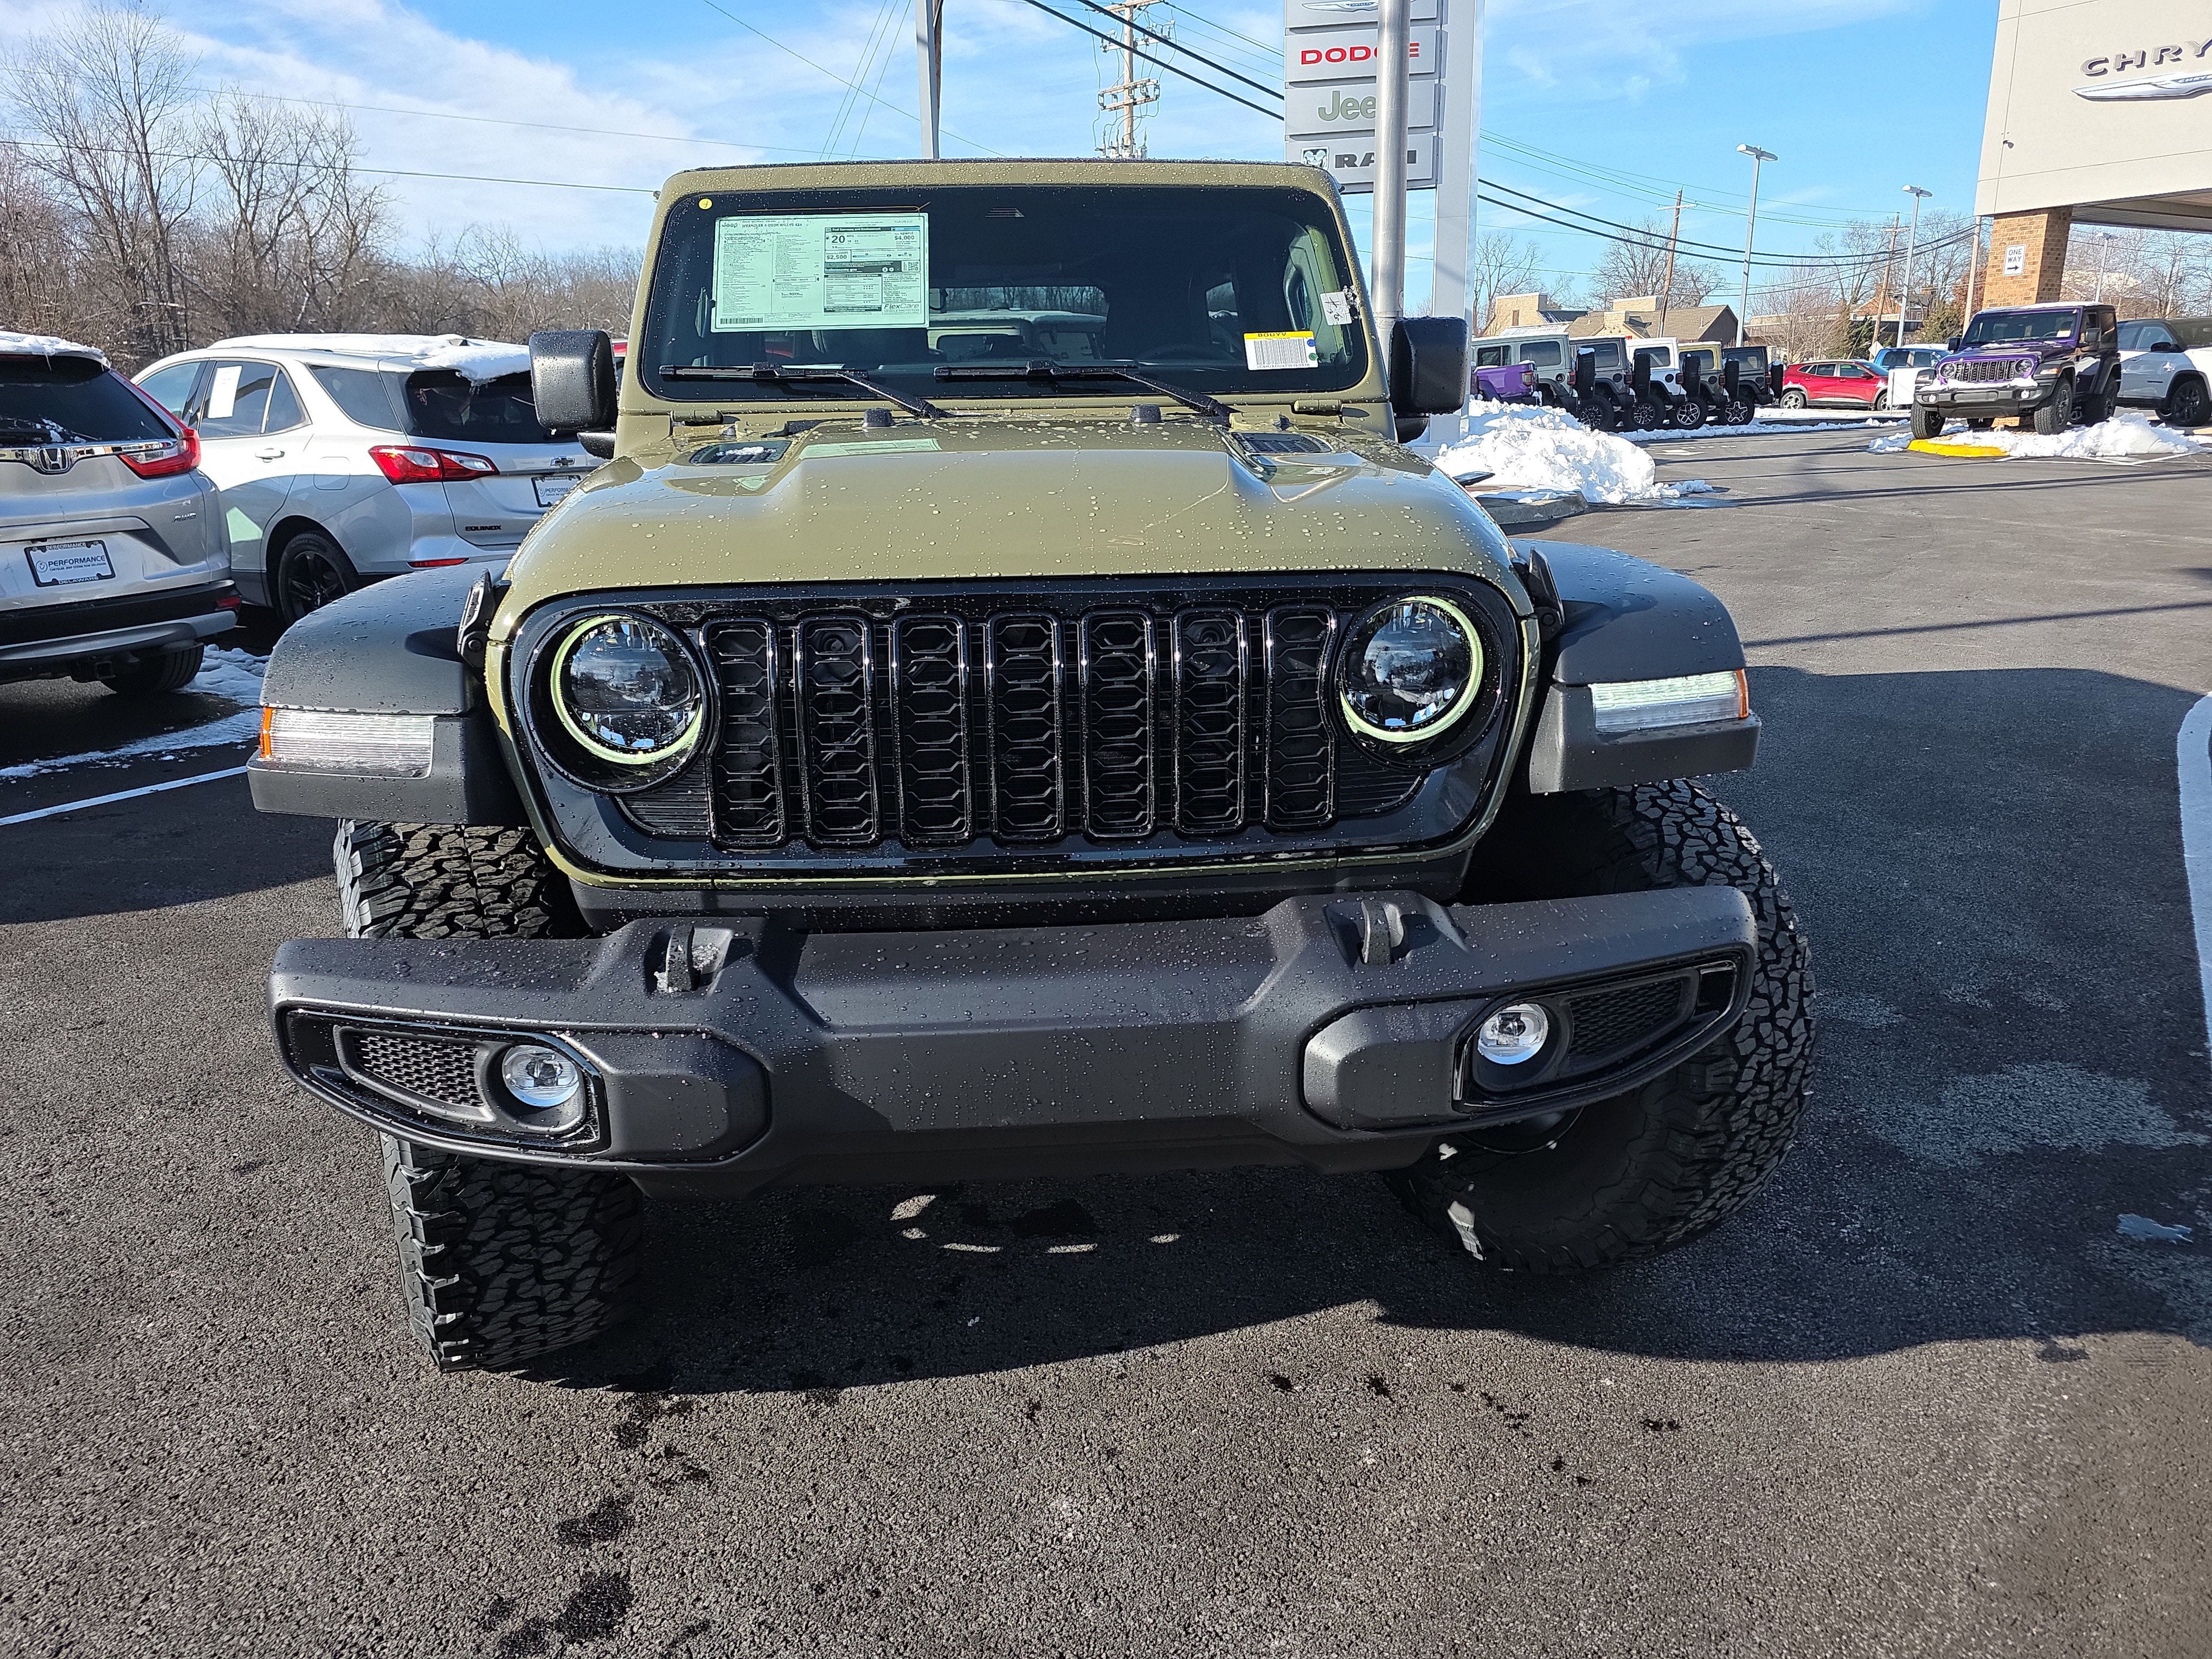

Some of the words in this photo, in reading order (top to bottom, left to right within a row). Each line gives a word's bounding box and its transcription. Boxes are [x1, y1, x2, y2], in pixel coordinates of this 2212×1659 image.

[1301, 42, 1420, 65] DODE
[1318, 90, 1376, 121] Jee
[1335, 150, 1417, 169] RA
[831, 235, 845, 243] 20
[48, 555, 105, 568] PERFORMANCE
